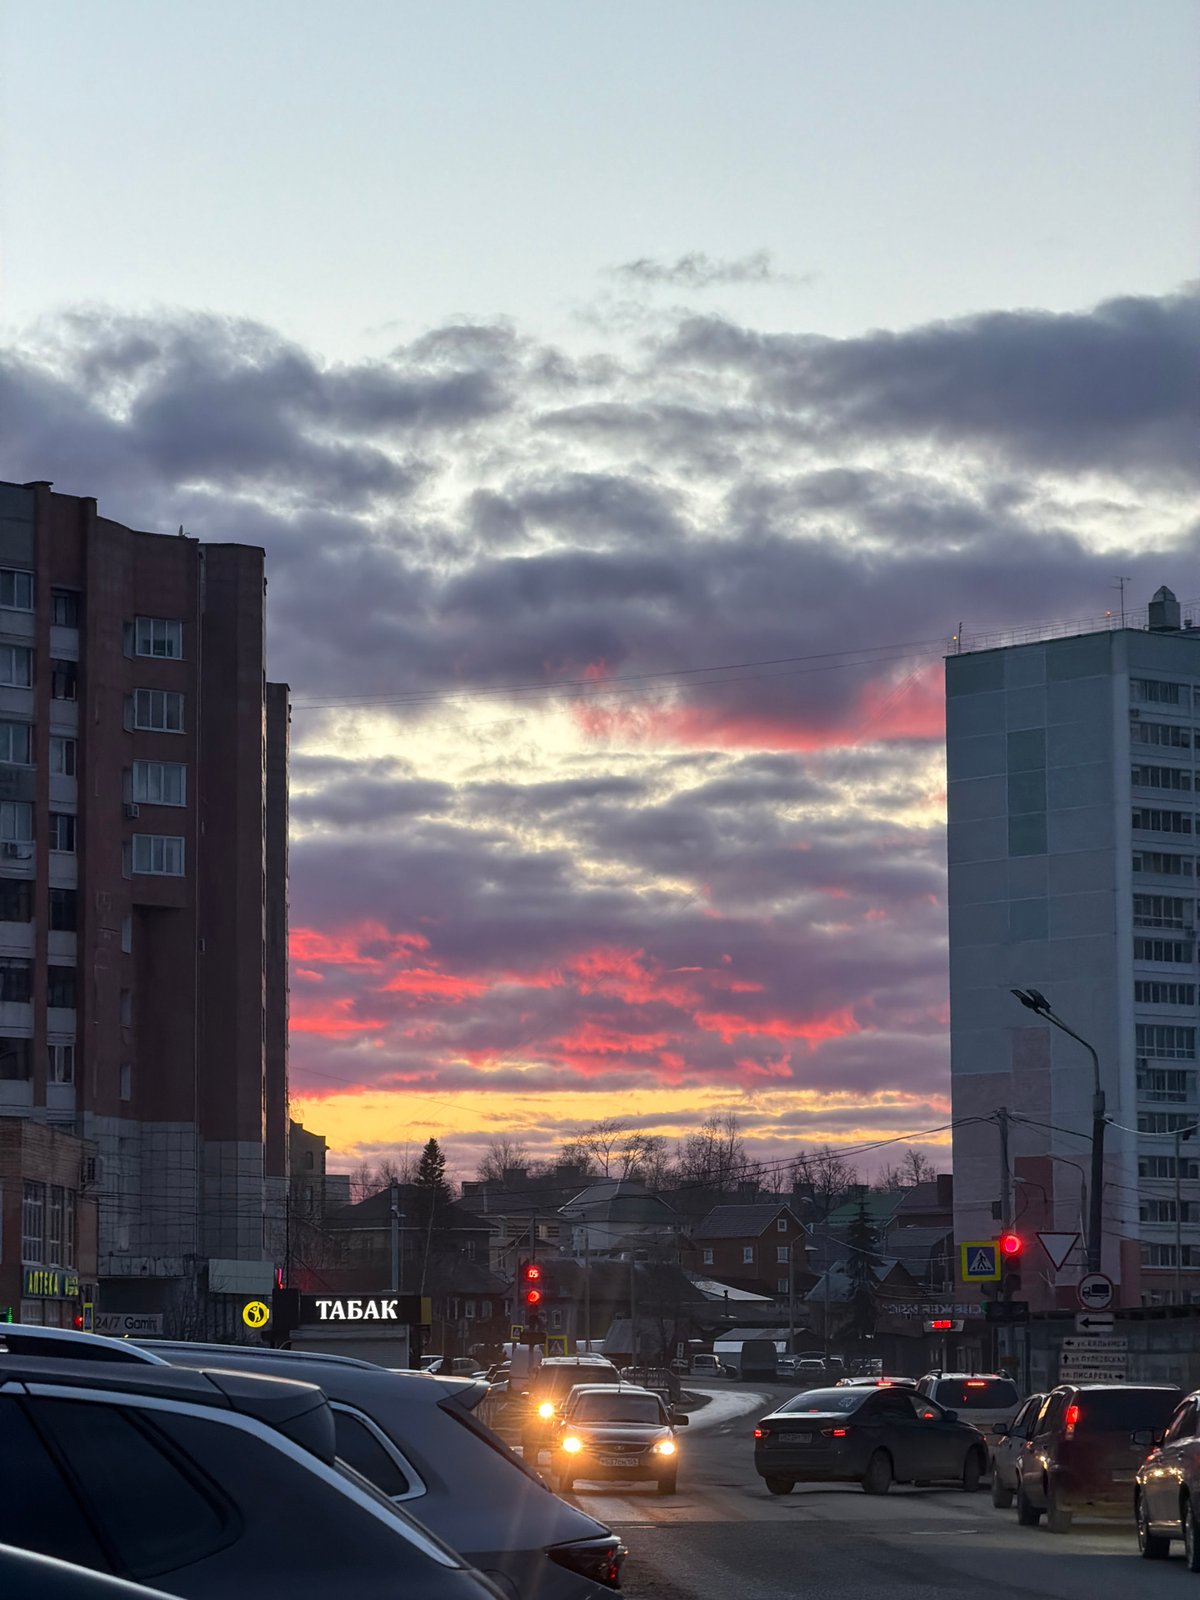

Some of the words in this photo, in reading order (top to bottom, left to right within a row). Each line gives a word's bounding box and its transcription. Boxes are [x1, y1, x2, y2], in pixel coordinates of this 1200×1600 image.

[28, 1270, 59, 1296] АПТЕКА
[315, 1299, 398, 1320] ТАБАК
[95, 1316, 121, 1330] 24/7
